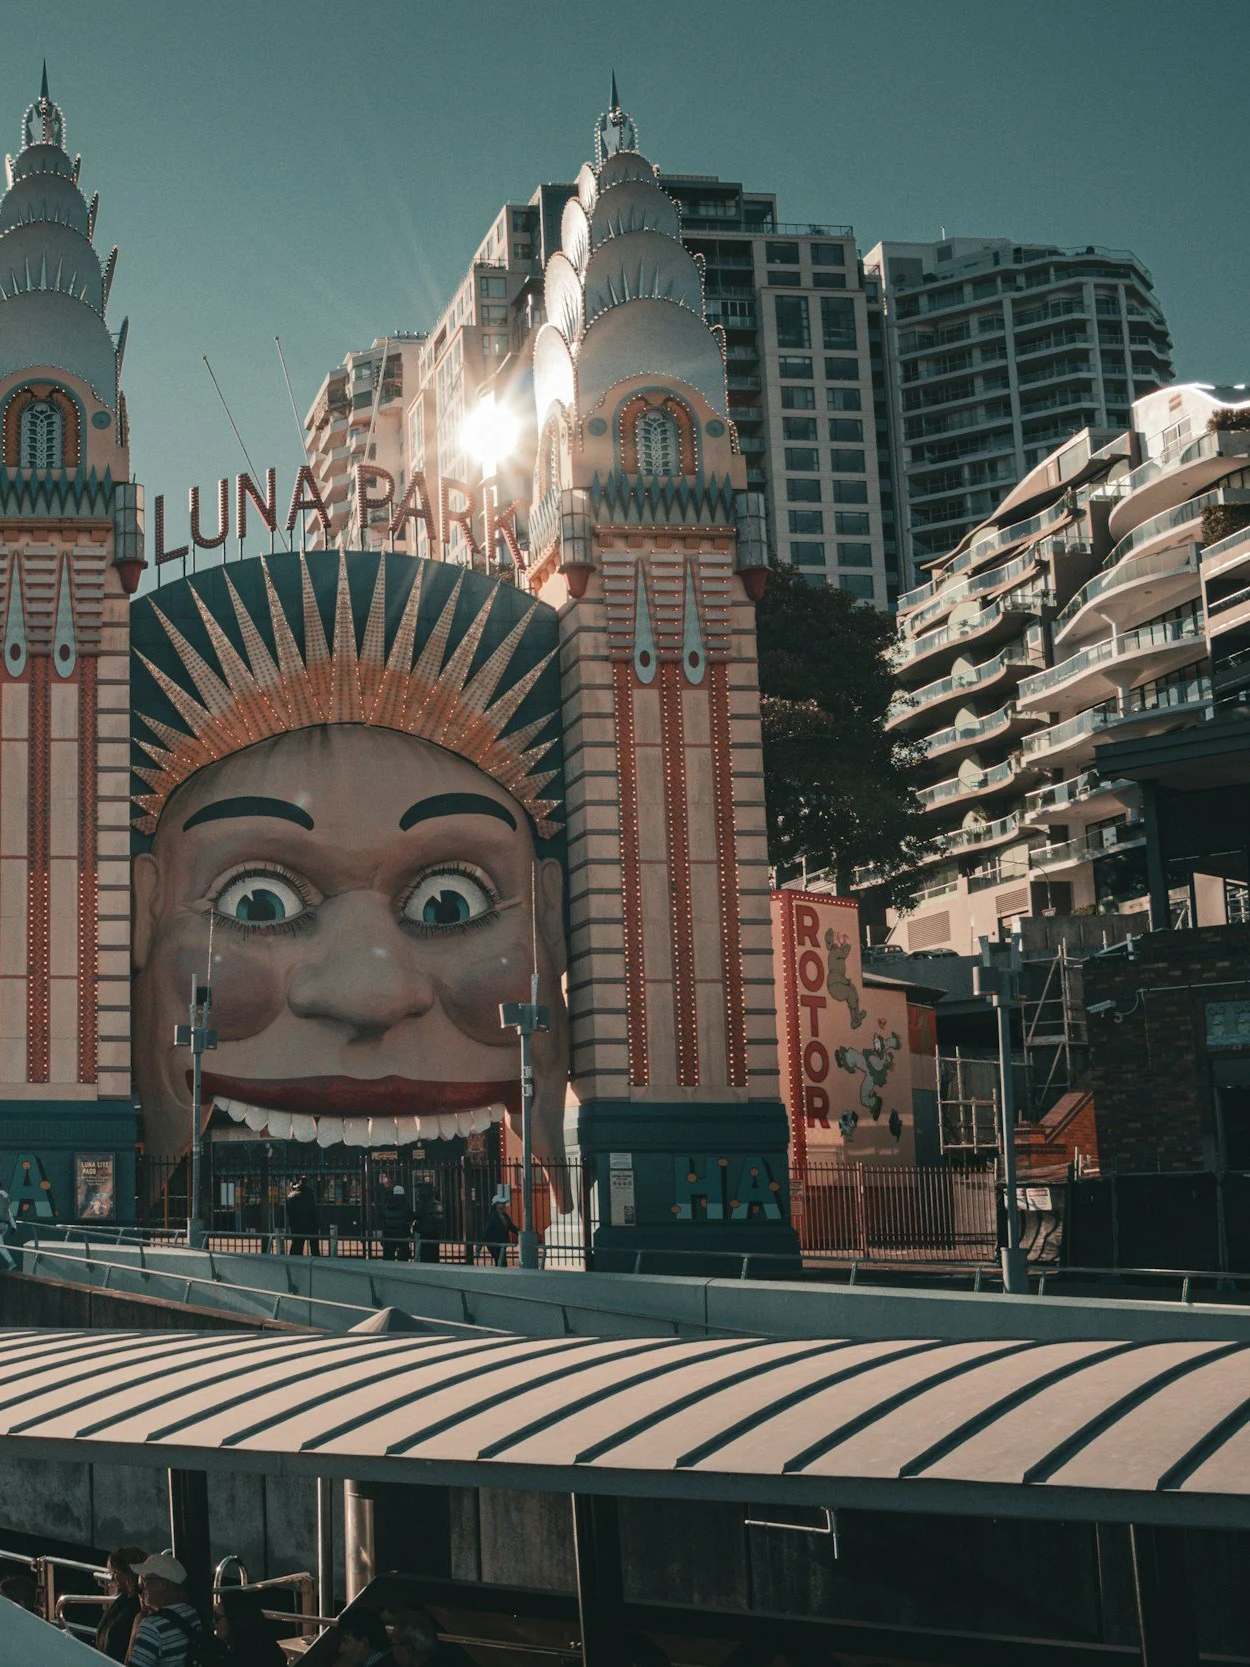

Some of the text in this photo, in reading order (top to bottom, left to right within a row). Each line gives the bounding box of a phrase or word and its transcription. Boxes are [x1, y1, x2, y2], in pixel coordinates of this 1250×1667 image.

[154, 463, 527, 571] LUNA PARK
[794, 903, 831, 1130] ROTOR
[673, 1156, 784, 1220] HA
